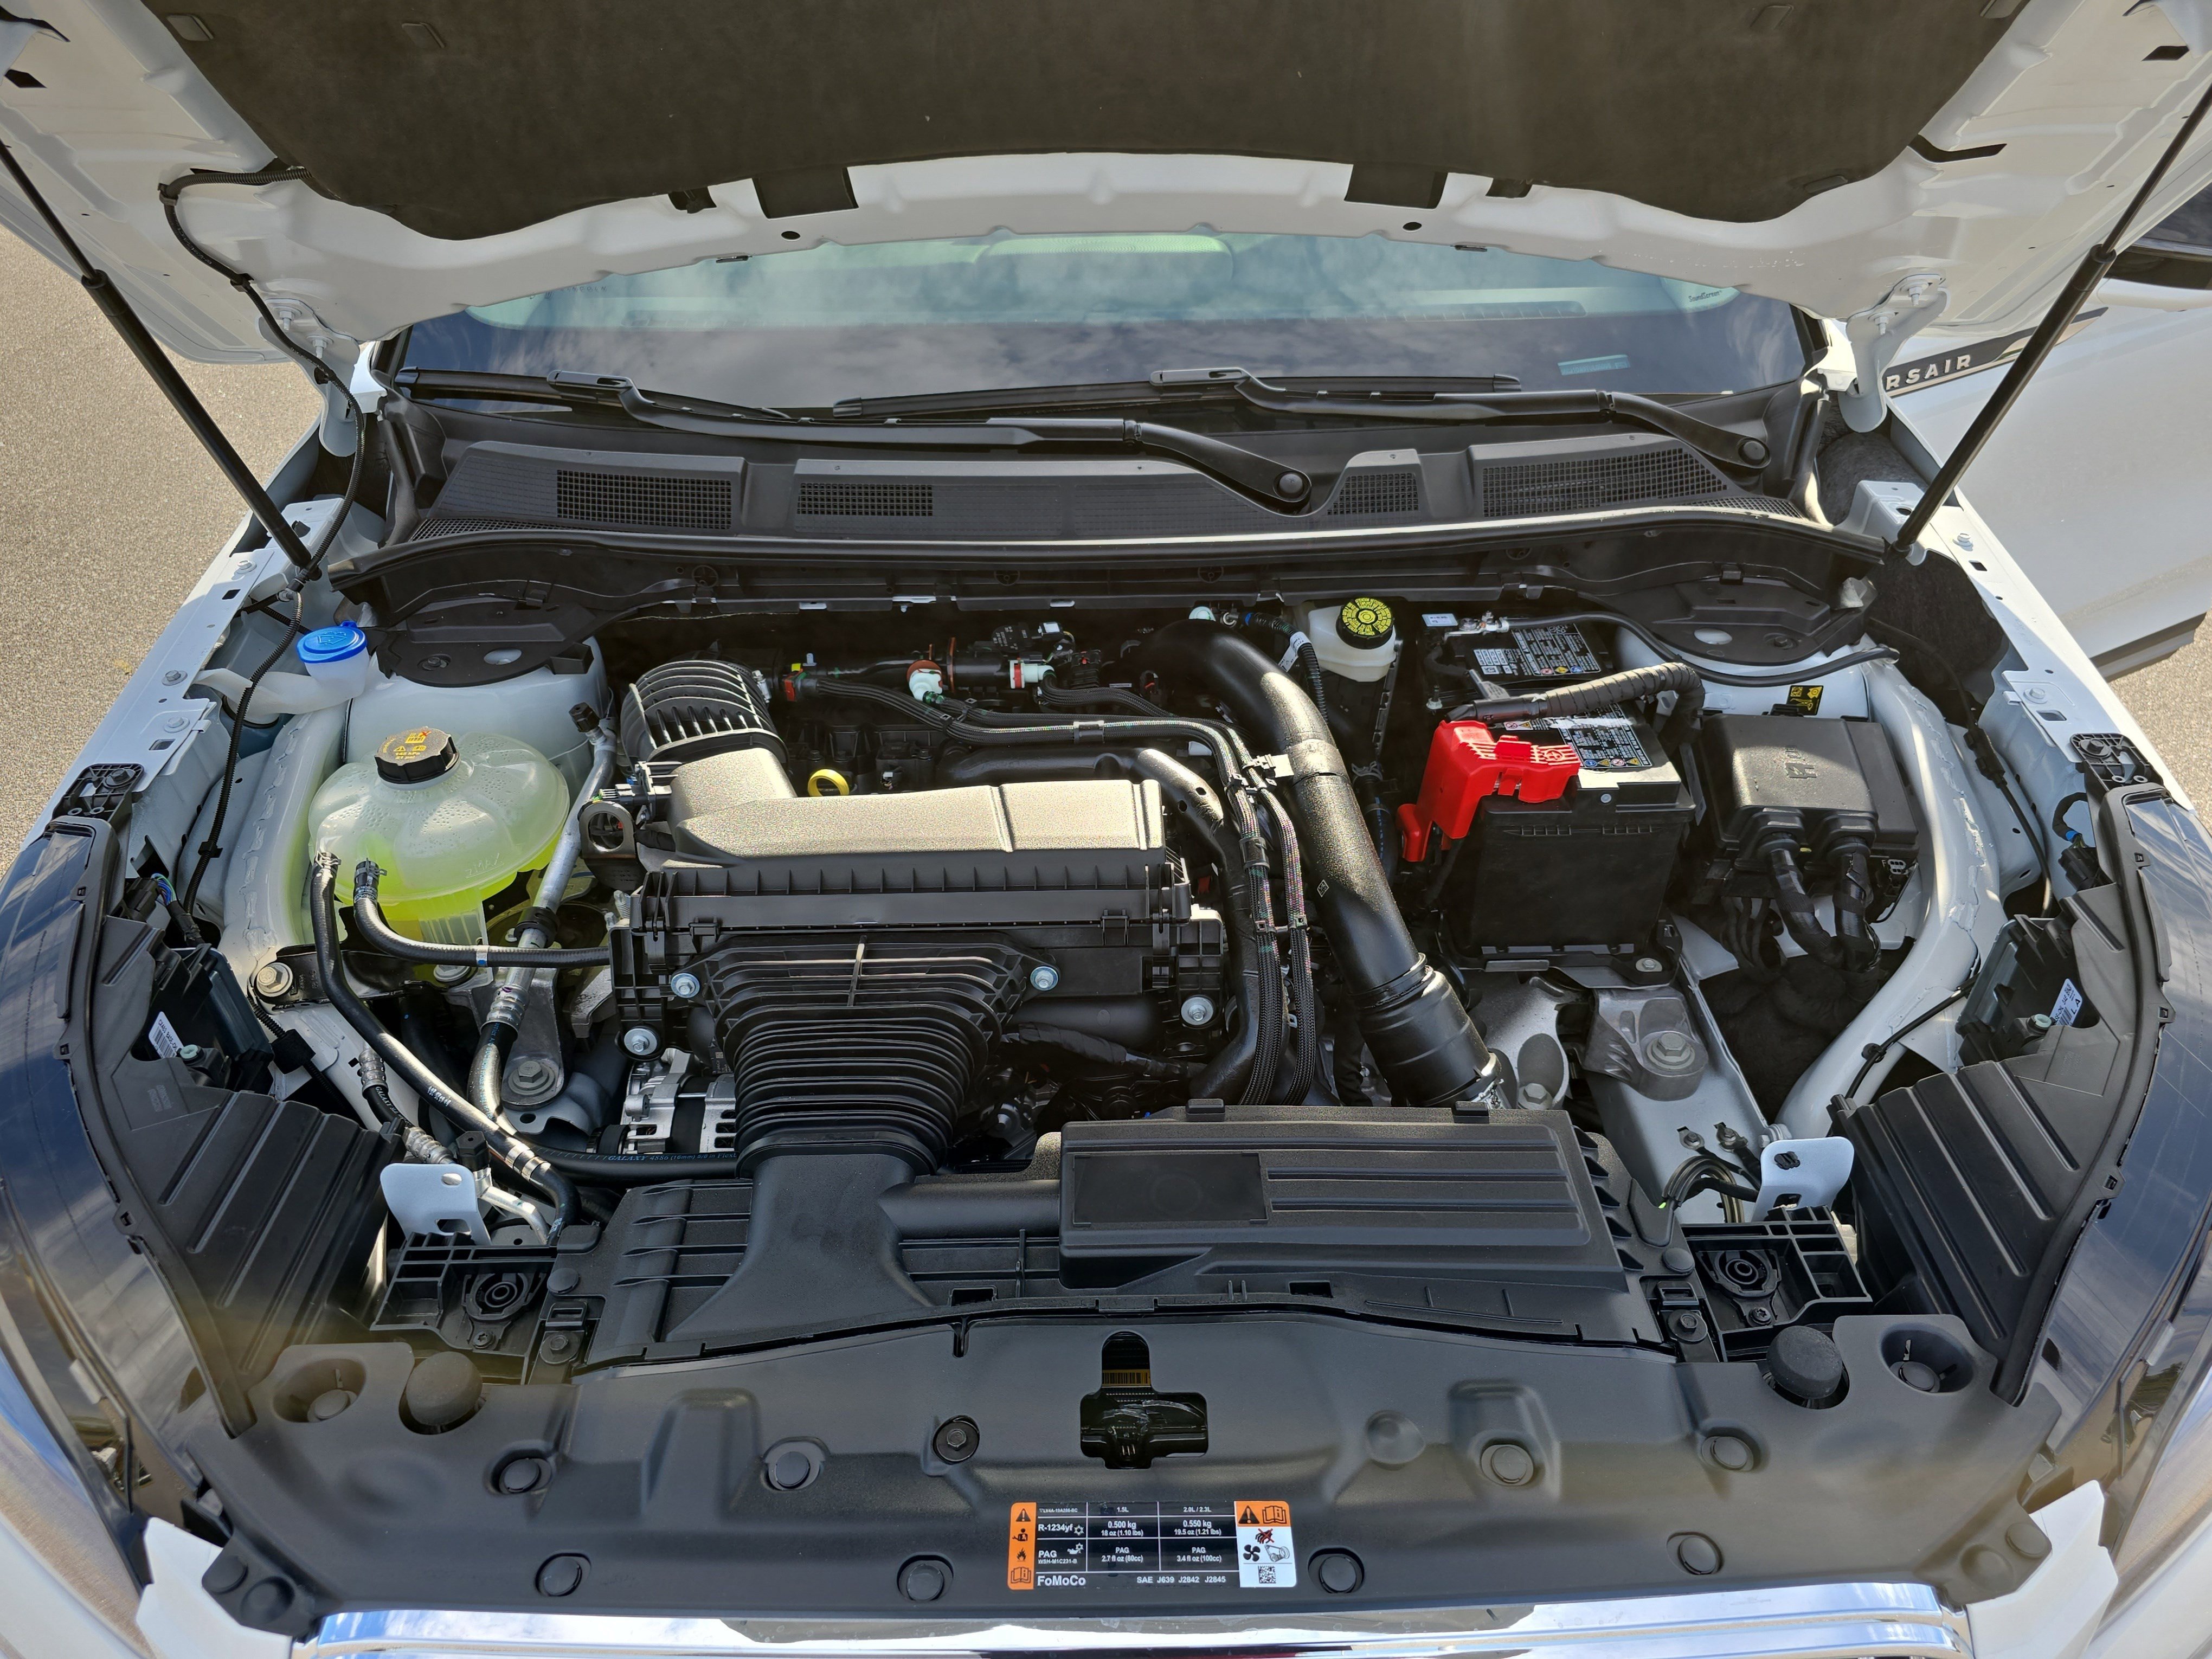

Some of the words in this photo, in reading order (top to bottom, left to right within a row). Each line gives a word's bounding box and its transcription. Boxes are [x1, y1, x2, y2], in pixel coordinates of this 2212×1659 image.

[1886, 354, 1971, 390] RSAIR
[1038, 1523, 1073, 1533] R-1234yf
[1108, 1520, 1127, 1529] 0.500
[1127, 1520, 1137, 1530] kg
[1182, 1520, 1202, 1528] 0.550
[1203, 1520, 1212, 1529] kg
[1117, 1529, 1131, 1537] (1.10
[1132, 1529, 1144, 1537] lbs)
[1038, 1550, 1057, 1558] PAG
[1200, 1554, 1222, 1563] (100cc)
[1037, 1575, 1086, 1586] FoMoCo
[1204, 1576, 1227, 1584] J2845
